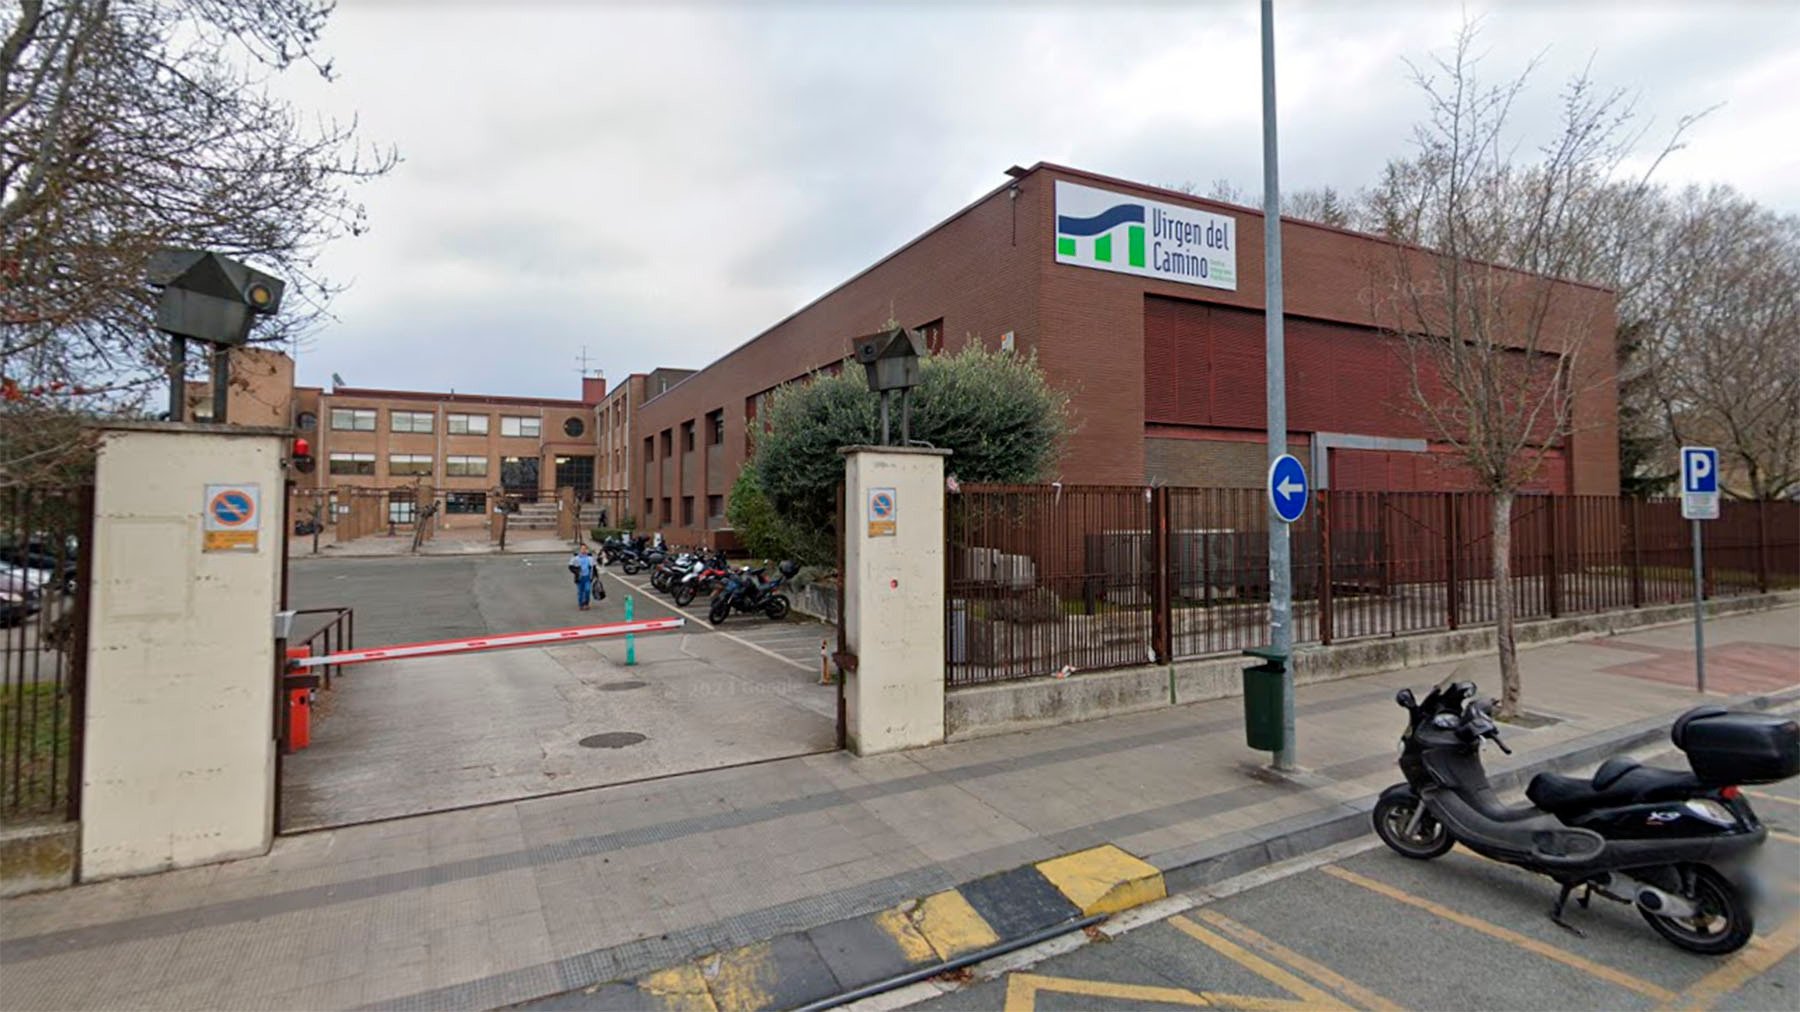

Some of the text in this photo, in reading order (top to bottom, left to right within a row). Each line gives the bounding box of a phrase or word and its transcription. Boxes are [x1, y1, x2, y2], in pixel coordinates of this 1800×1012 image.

[1153, 208, 1229, 251] Virgen del
[1153, 241, 1208, 278] Camino
[1690, 452, 1711, 490] P
